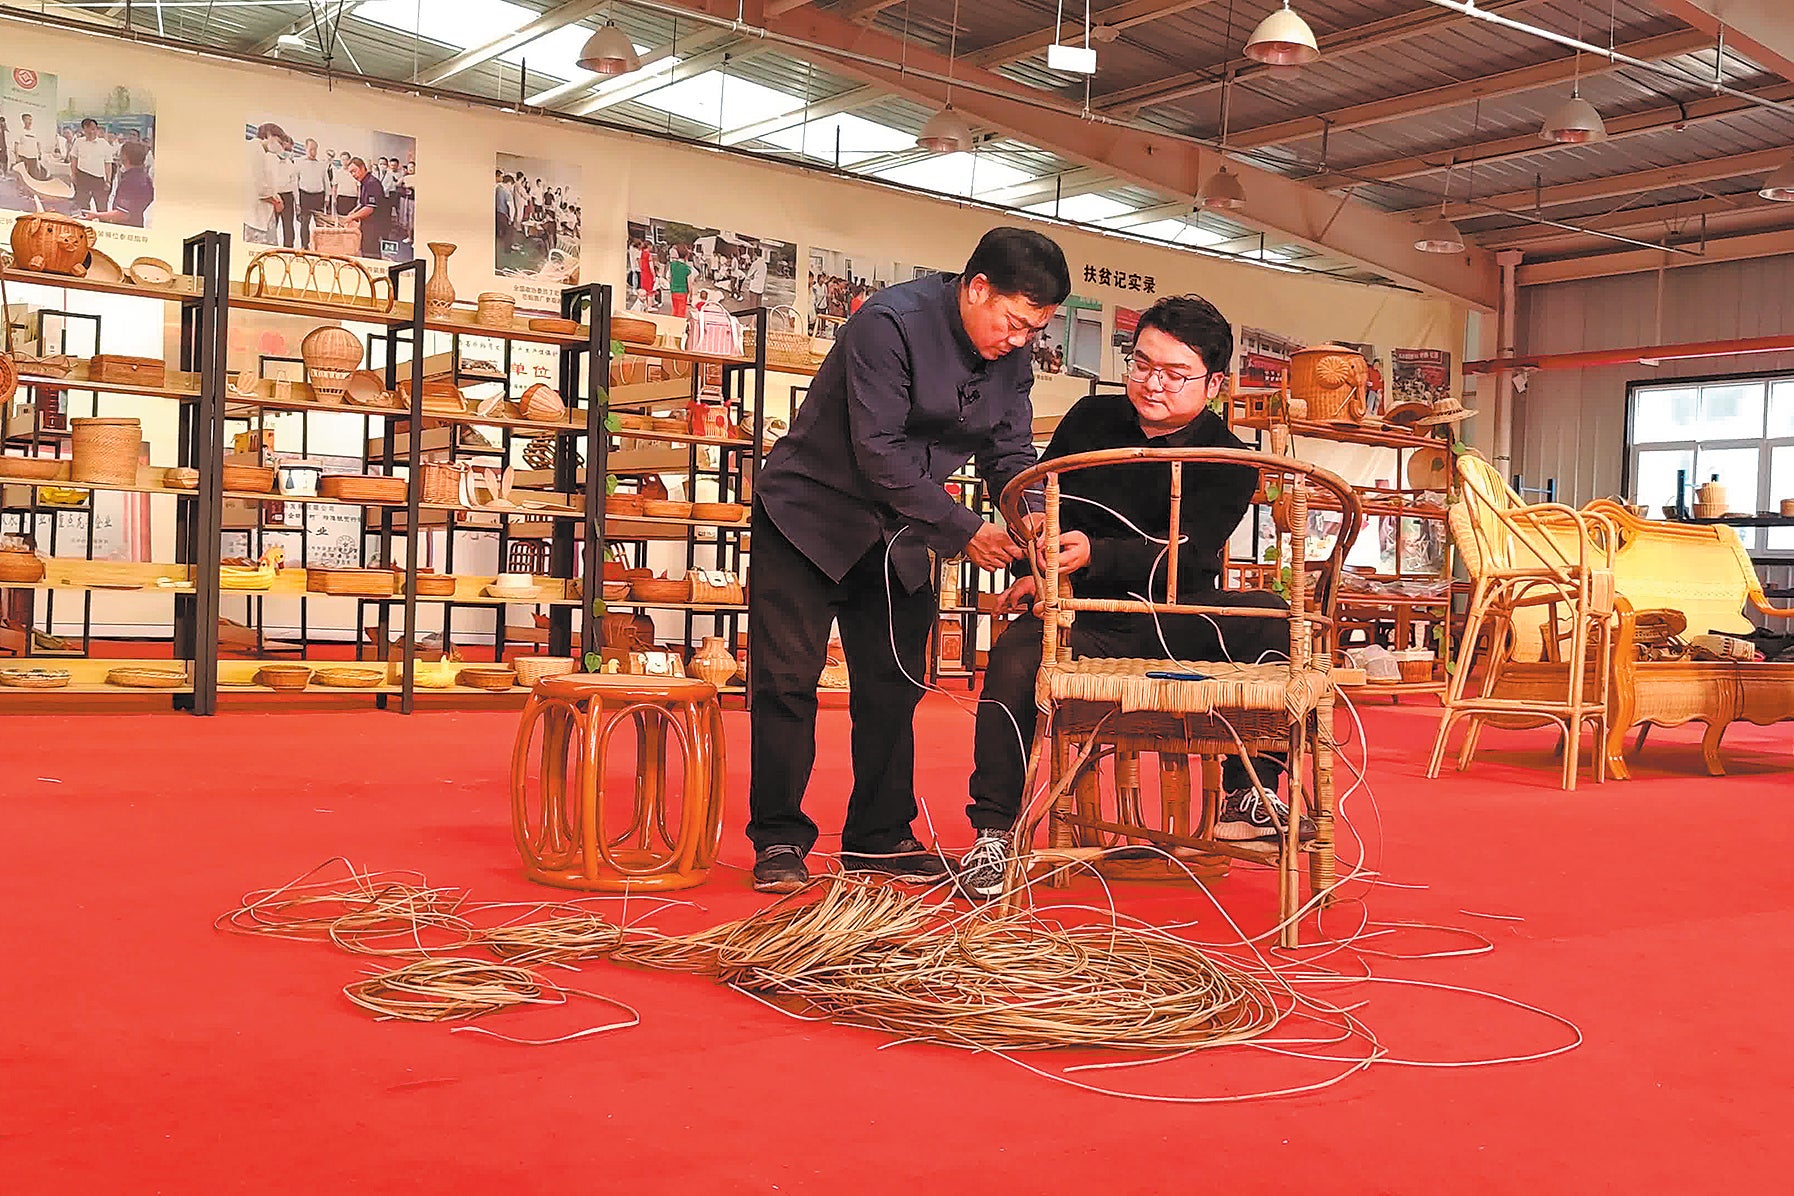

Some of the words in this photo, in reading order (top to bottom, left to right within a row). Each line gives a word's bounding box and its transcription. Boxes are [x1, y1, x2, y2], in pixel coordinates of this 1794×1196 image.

[1083, 264, 1156, 294] 扶贫记实录
[511, 362, 552, 379] 单位
